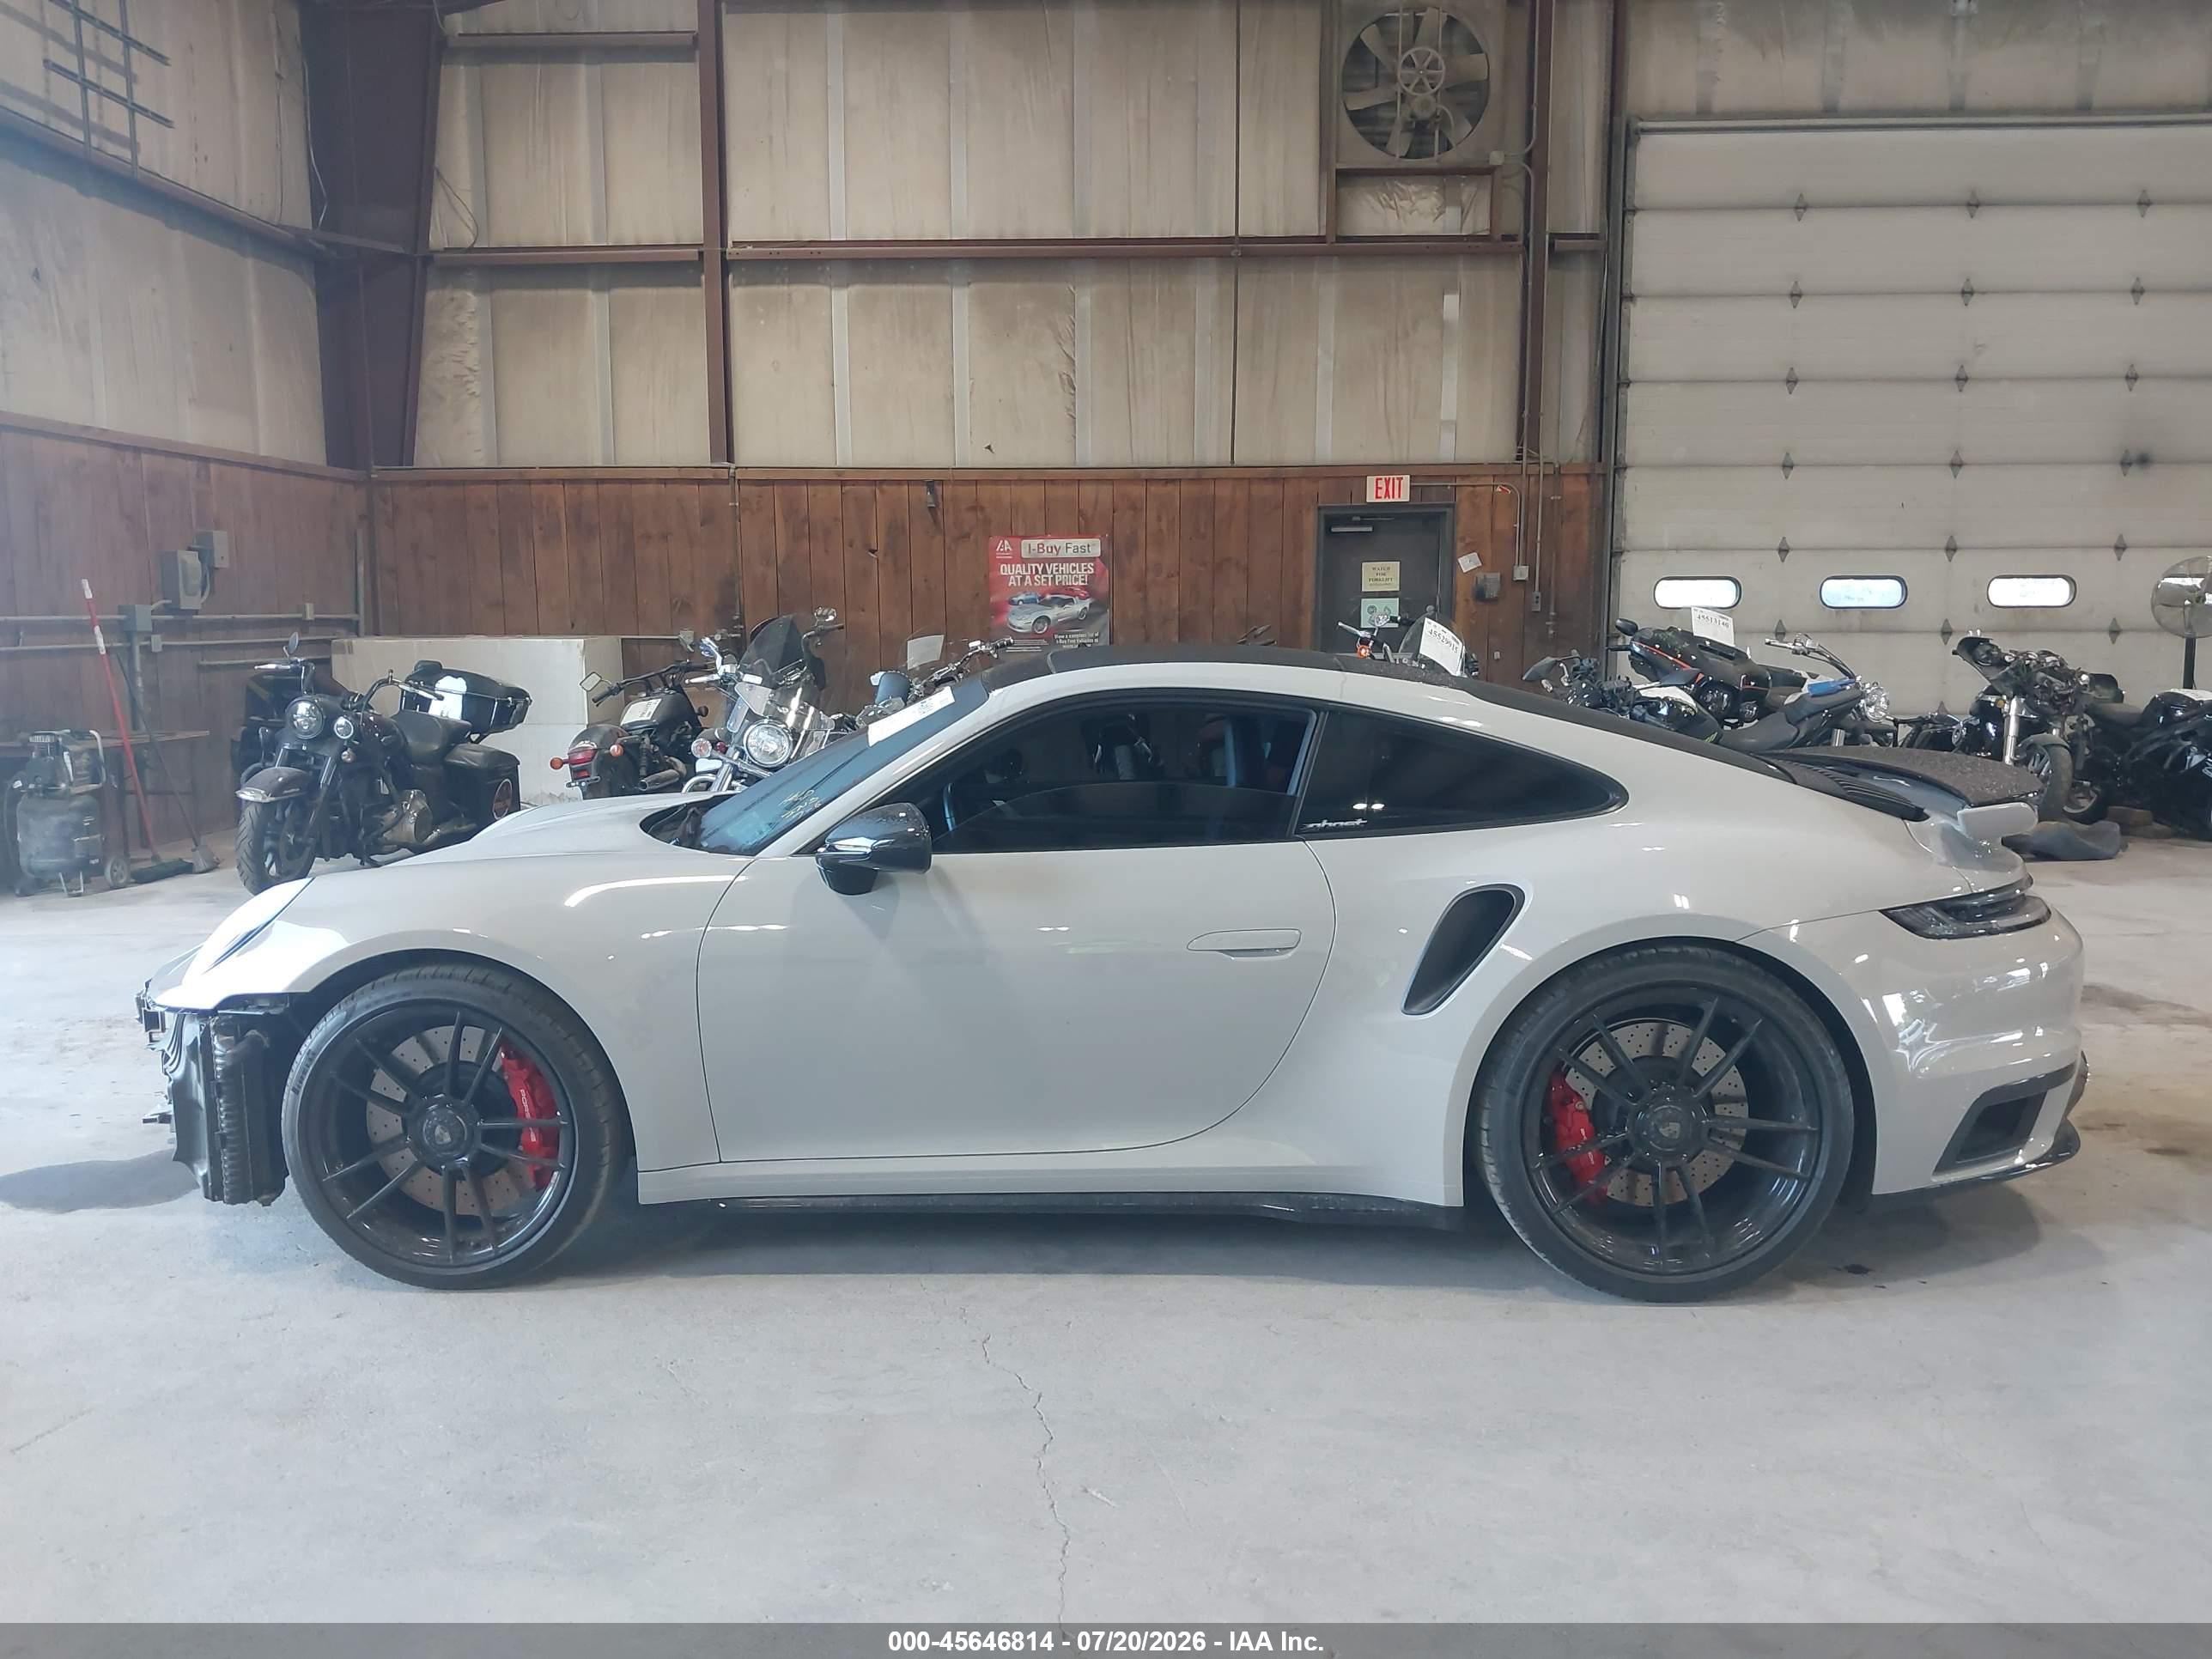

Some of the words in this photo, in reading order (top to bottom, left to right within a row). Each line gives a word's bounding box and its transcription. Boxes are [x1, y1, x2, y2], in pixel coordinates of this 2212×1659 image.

[1375, 477, 1403, 499] EXIT
[1028, 543, 1061, 556] I-Buy
[1066, 542, 1091, 554] Fast
[1000, 562, 1043, 575] QUALITY
[1045, 562, 1095, 574] VEHICLES
[1008, 574, 1023, 586] AT
[1024, 574, 1032, 586] A
[1034, 574, 1054, 586] SET
[1055, 574, 1089, 586] PRICE!
